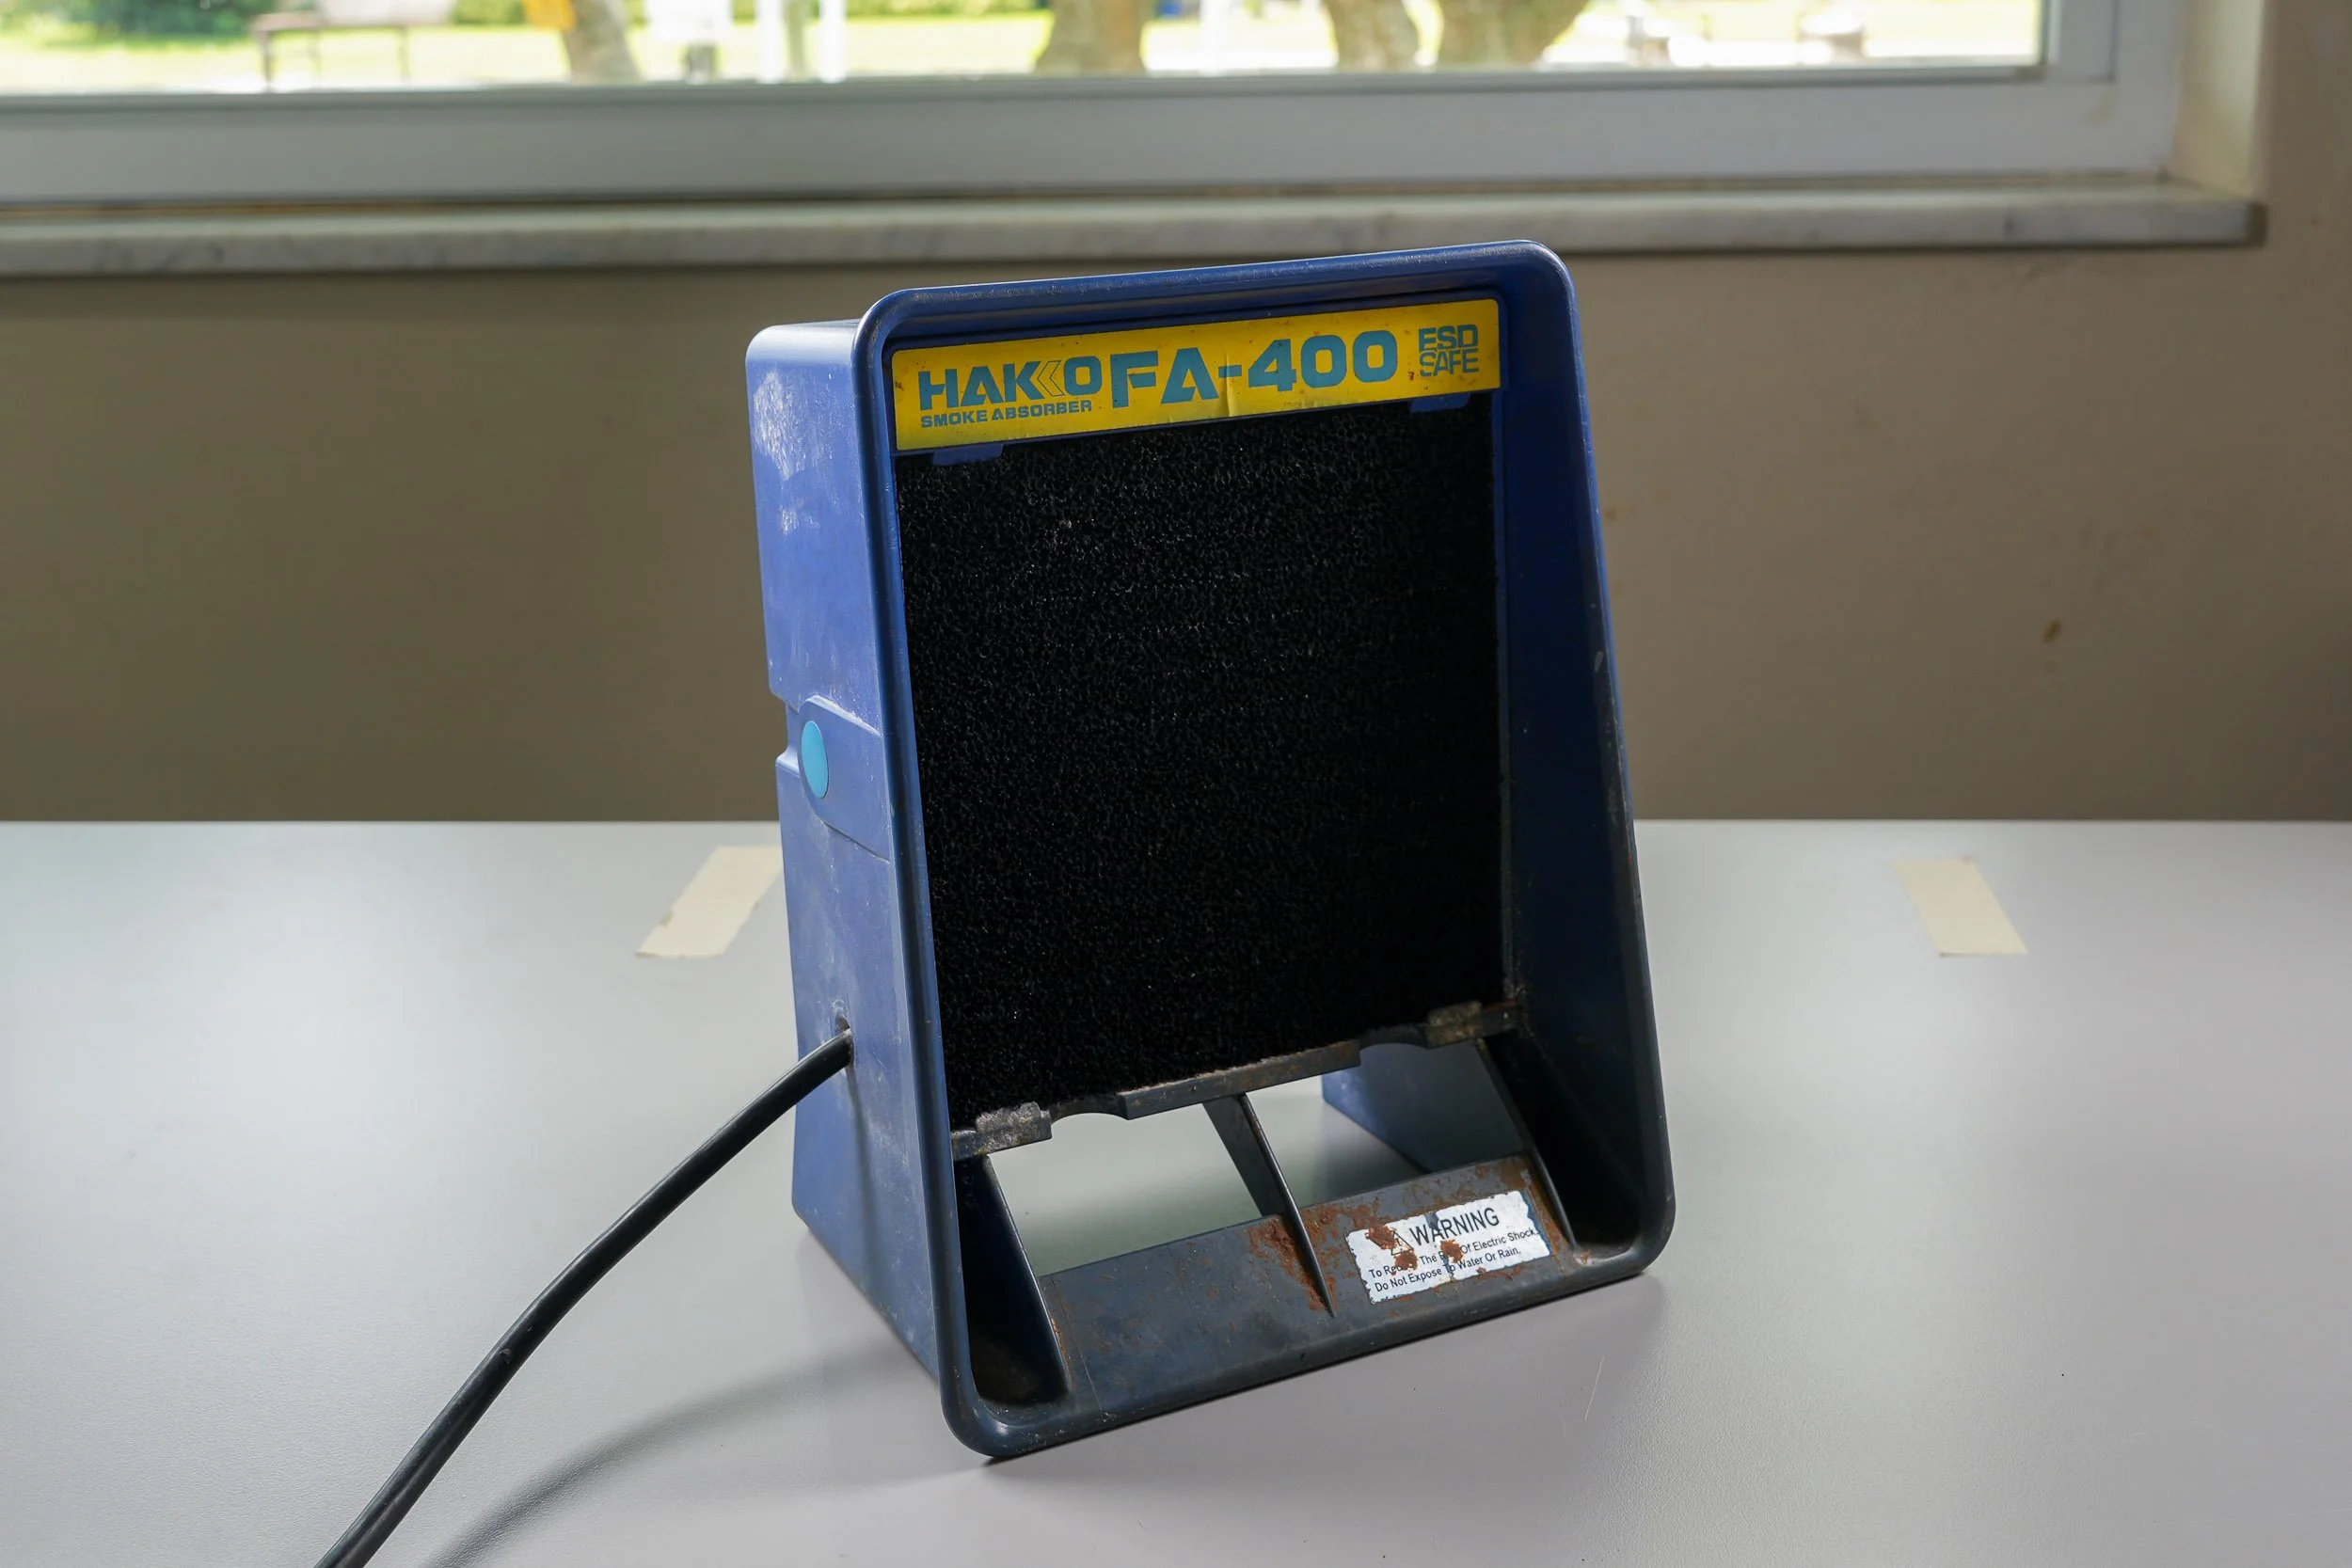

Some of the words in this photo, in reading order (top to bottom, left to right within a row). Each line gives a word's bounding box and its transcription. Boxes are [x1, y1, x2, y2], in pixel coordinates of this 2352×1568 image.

[1418, 324, 1479, 353] ESD
[1110, 329, 1398, 408] FA-400
[1419, 347, 1480, 377] SAFE
[921, 409, 988, 429] SMOKE
[992, 399, 1092, 421] ABSORBER
[1409, 1207, 1500, 1246] WARNING
[1369, 1268, 1383, 1279] To
[1419, 1253, 1438, 1265] The
[1460, 1243, 1471, 1254] Of
[1472, 1235, 1506, 1252] Electric
[1375, 1282, 1389, 1292] Do
[1390, 1275, 1407, 1289] Not
[1408, 1267, 1442, 1283] Expose
[1457, 1256, 1484, 1269] Water
[1485, 1252, 1497, 1262] Or
[1497, 1246, 1521, 1259] Rain.
